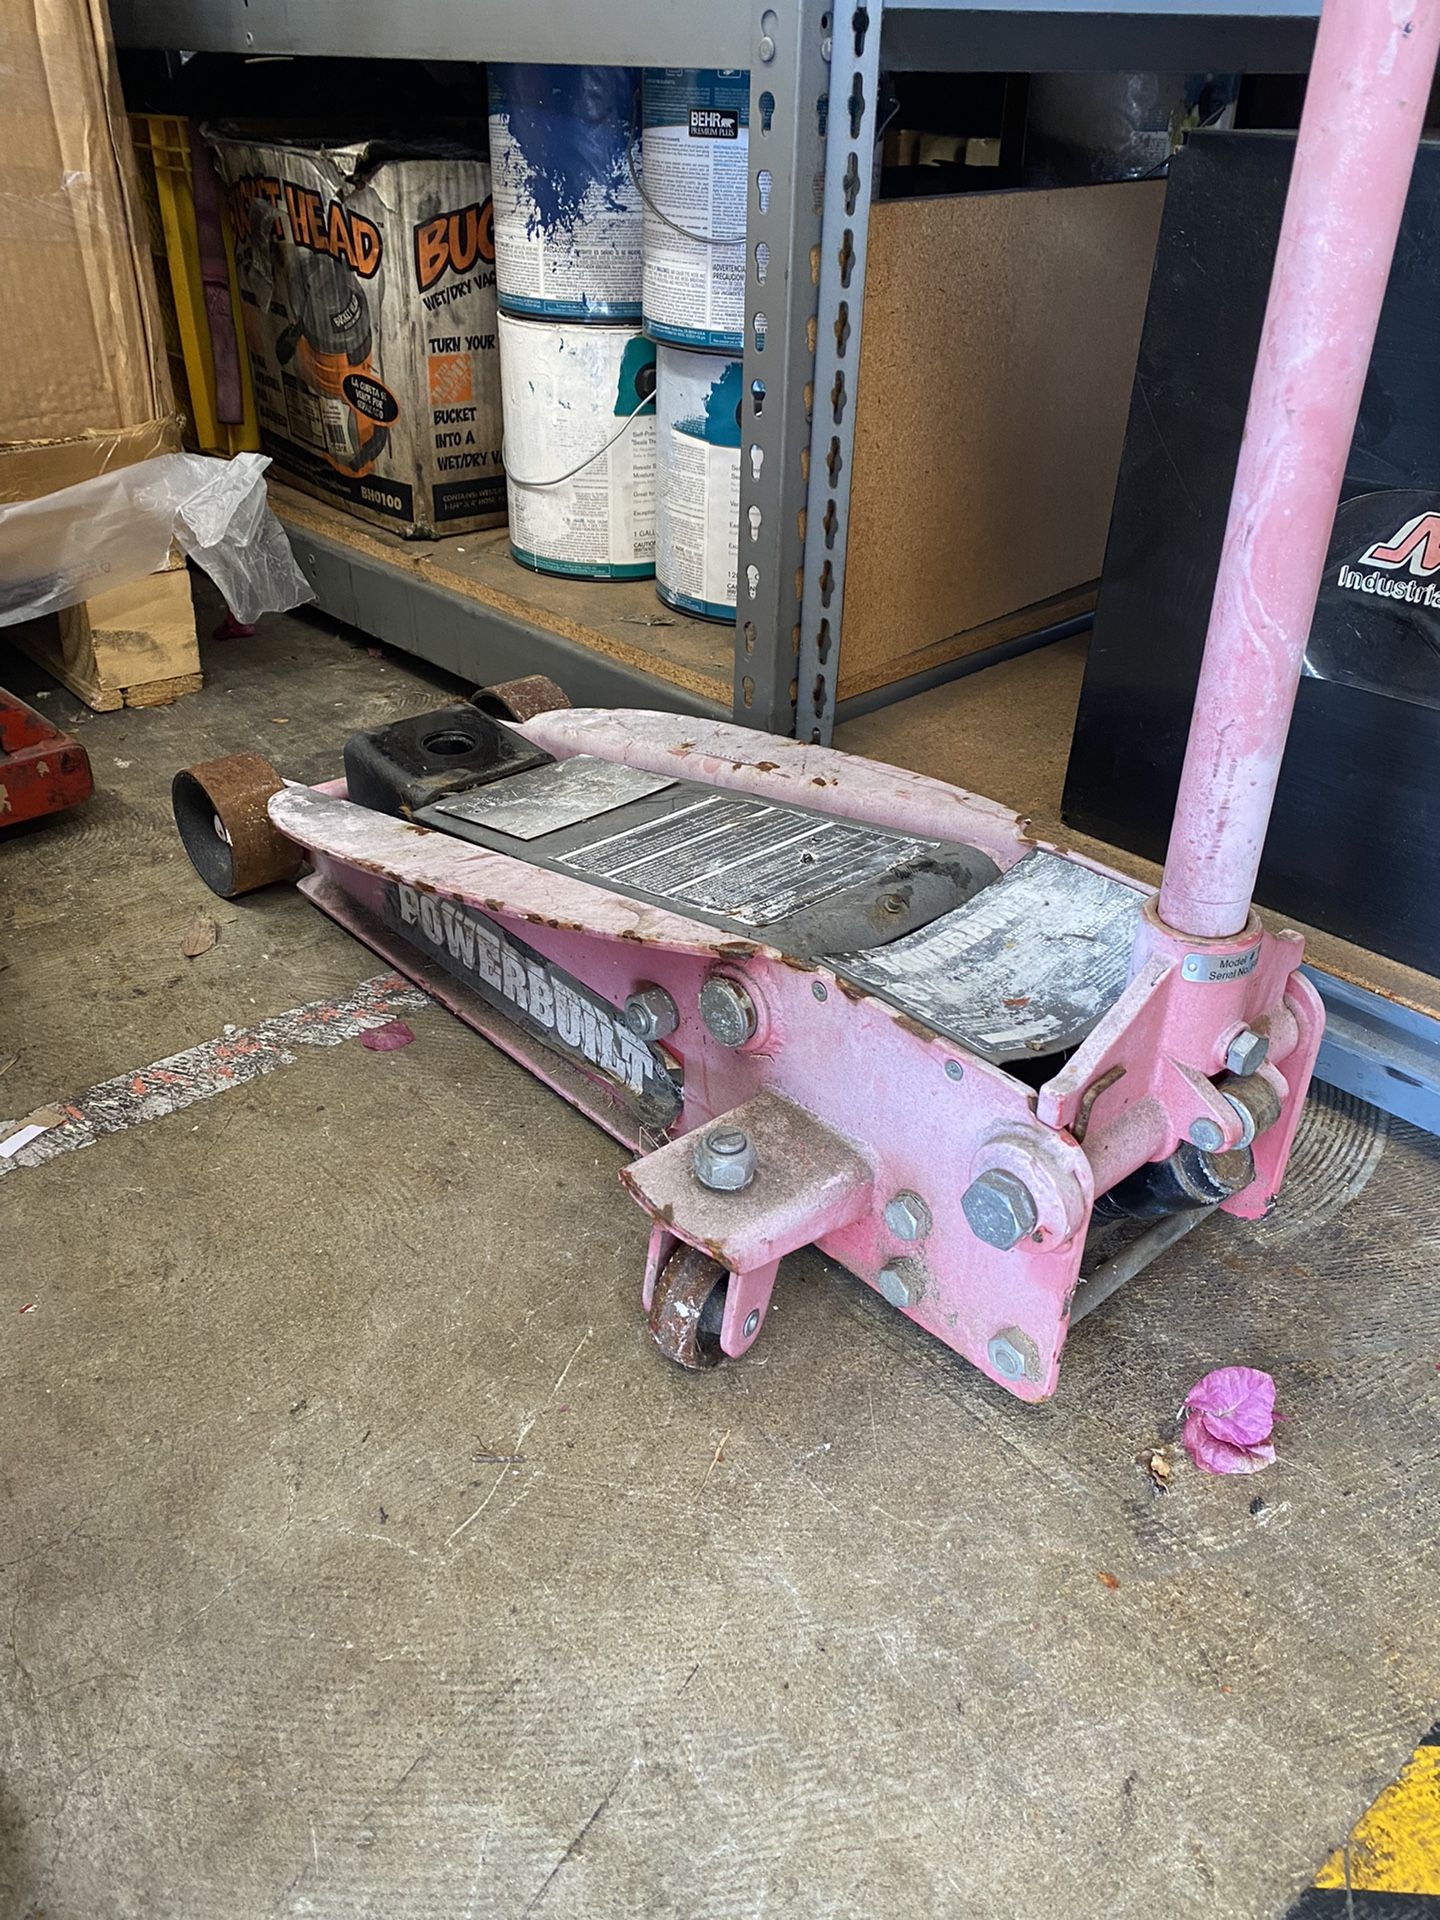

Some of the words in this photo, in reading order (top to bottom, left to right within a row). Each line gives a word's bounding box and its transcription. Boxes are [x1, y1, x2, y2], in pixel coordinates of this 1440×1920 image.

[690, 111, 721, 128] BEHR
[690, 127, 717, 136] PREMIUM
[719, 128, 735, 137] PLUS
[282, 179, 383, 279] HEAD
[423, 279, 472, 311] WET/DRY
[429, 336, 461, 354] TURN
[465, 334, 496, 351] YOUR
[433, 407, 477, 425] BUCKET
[435, 431, 462, 449] INTO
[465, 430, 476, 445] A
[437, 451, 488, 472] WET/DRY
[360, 485, 403, 511] BH0100
[1219, 955, 1248, 969] Model
[1208, 969, 1237, 980] Serial
[398, 882, 654, 1095] POWERBUILT
